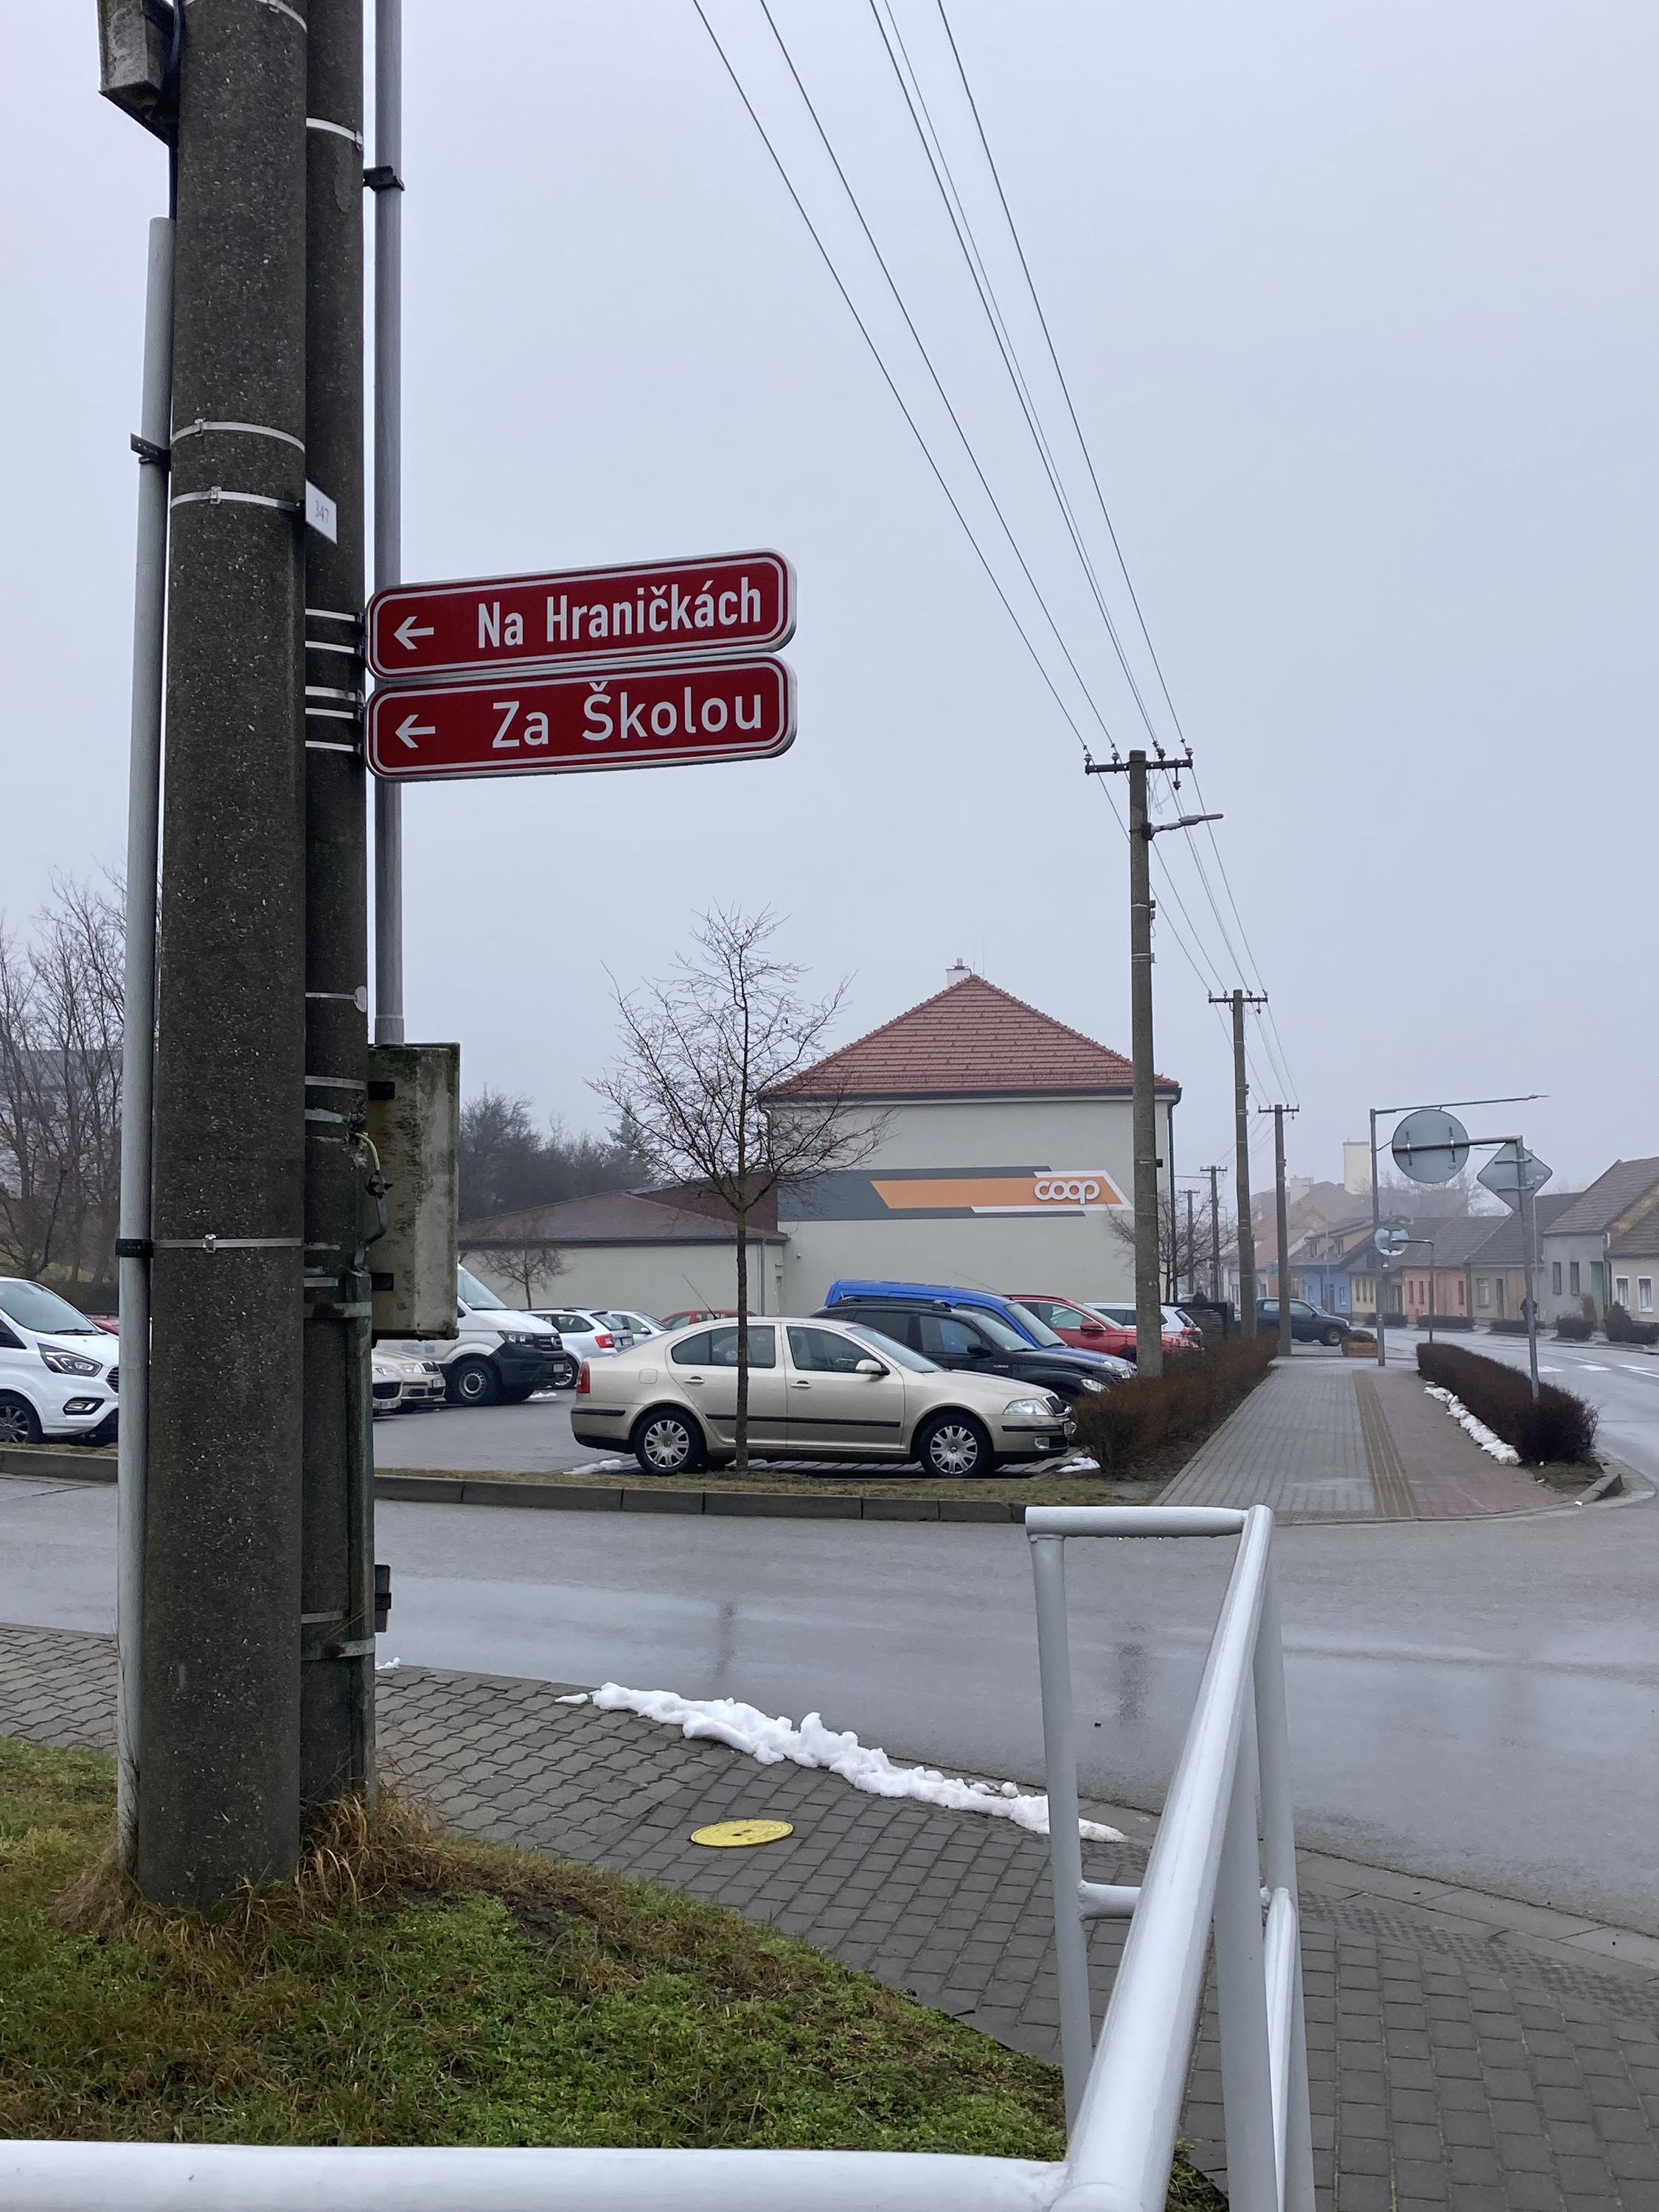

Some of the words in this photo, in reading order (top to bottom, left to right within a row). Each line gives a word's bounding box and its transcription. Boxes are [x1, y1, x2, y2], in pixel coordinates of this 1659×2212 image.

[477, 601, 524, 649] Na
[546, 576, 762, 642] Hraničkách
[492, 700, 549, 748] Za
[582, 681, 762, 741] Školou
[1034, 1180, 1100, 1205] coop
